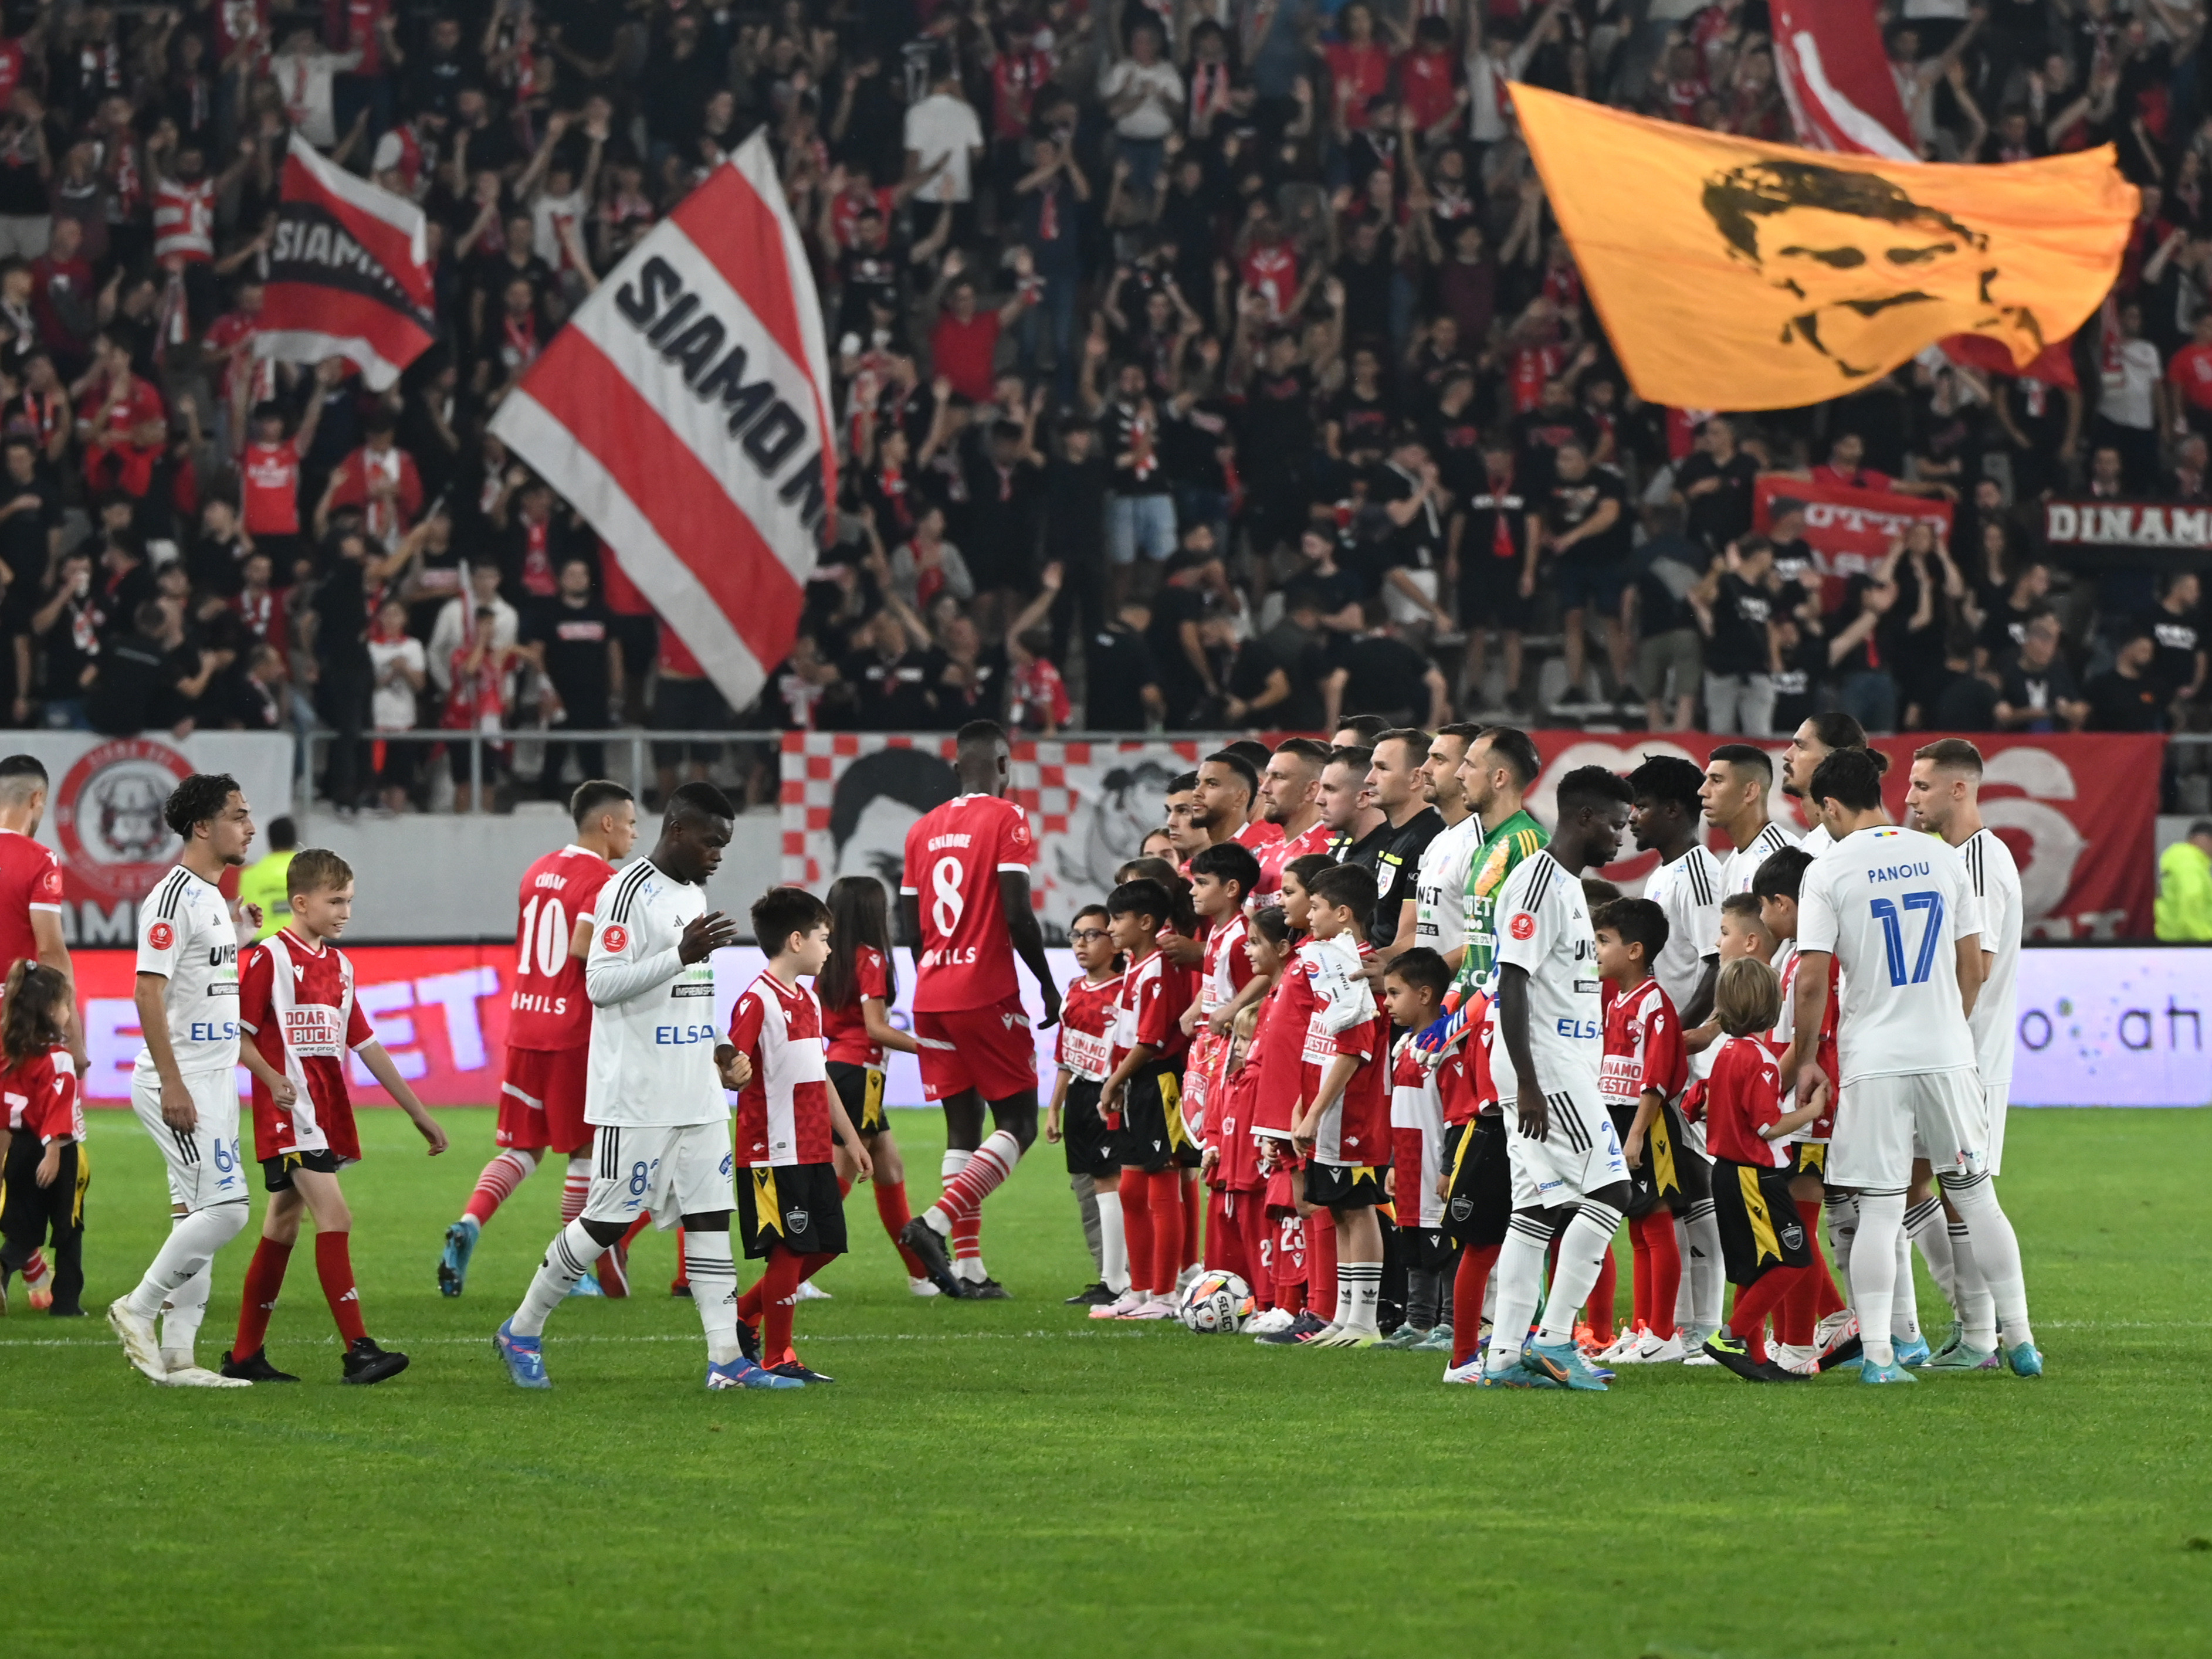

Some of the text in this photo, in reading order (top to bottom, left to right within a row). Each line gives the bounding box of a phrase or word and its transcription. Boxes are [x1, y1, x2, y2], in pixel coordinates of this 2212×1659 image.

[2047, 503, 2211, 547] DINAM
[1868, 861, 1930, 884] PANOIU
[932, 856, 964, 937] 8
[517, 895, 569, 978] 10
[1870, 891, 1945, 988] 17
[285, 1011, 325, 1026] DOAR
[655, 1024, 716, 1044] ELSA
[4, 1091, 28, 1129] 7
[1281, 1216, 1307, 1251] 23
